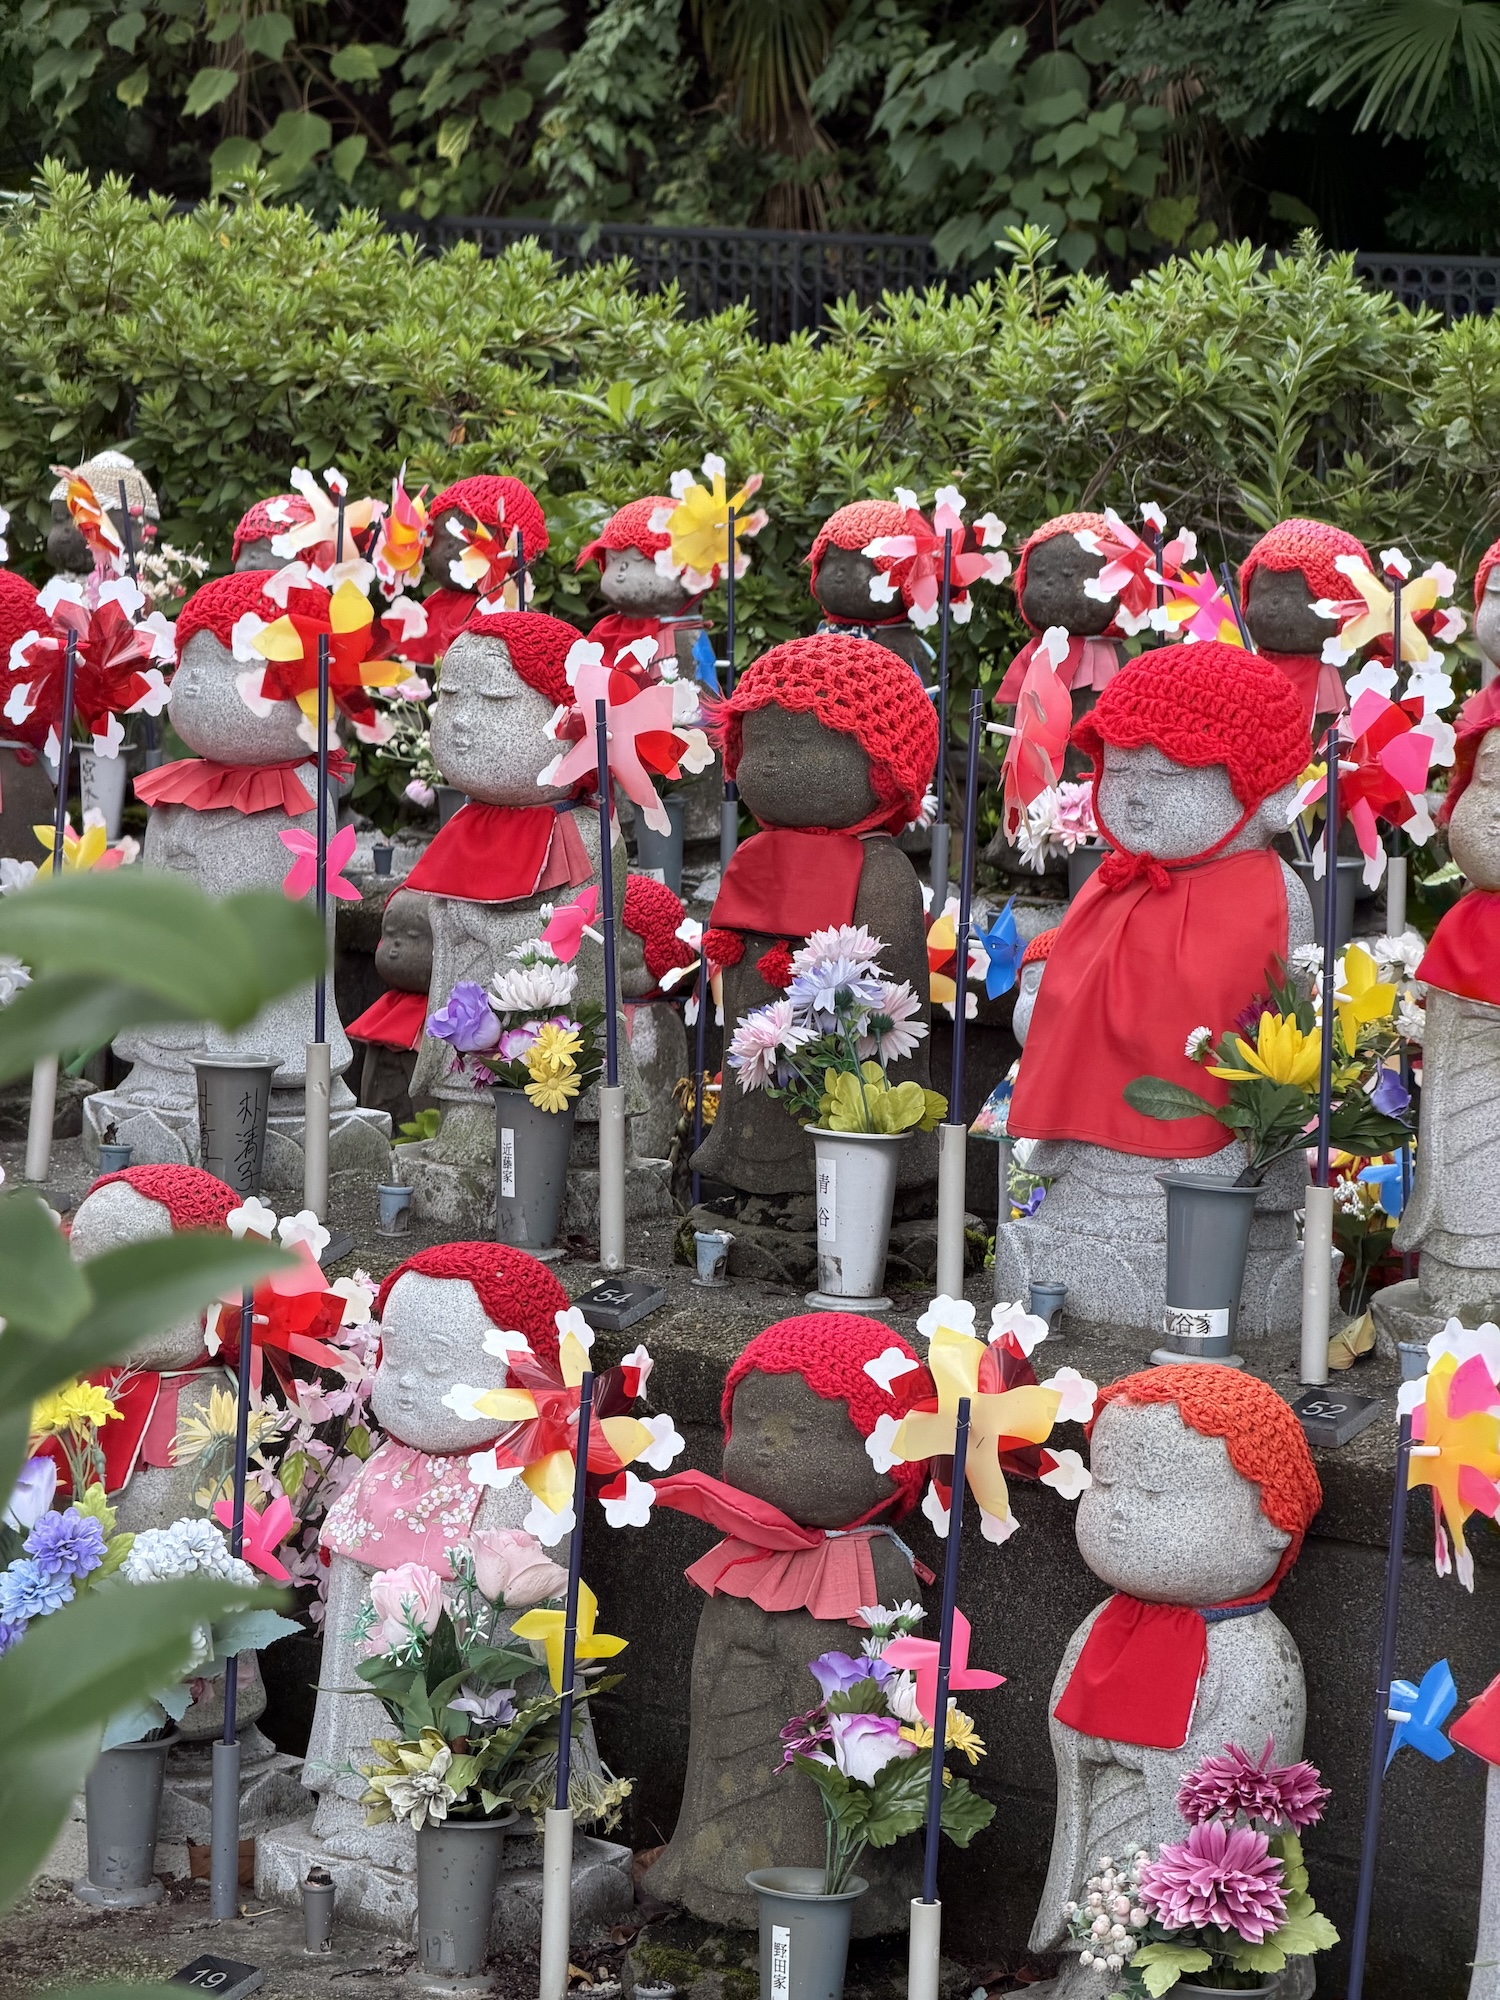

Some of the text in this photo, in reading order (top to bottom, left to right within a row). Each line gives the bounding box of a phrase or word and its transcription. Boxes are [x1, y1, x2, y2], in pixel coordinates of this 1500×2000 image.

[502, 1142, 513, 1184] 近藤家
[592, 1288, 634, 1305] 54
[1301, 1400, 1348, 1420] 52
[773, 1941, 788, 1990] 野田家
[188, 1968, 228, 1989] 19
